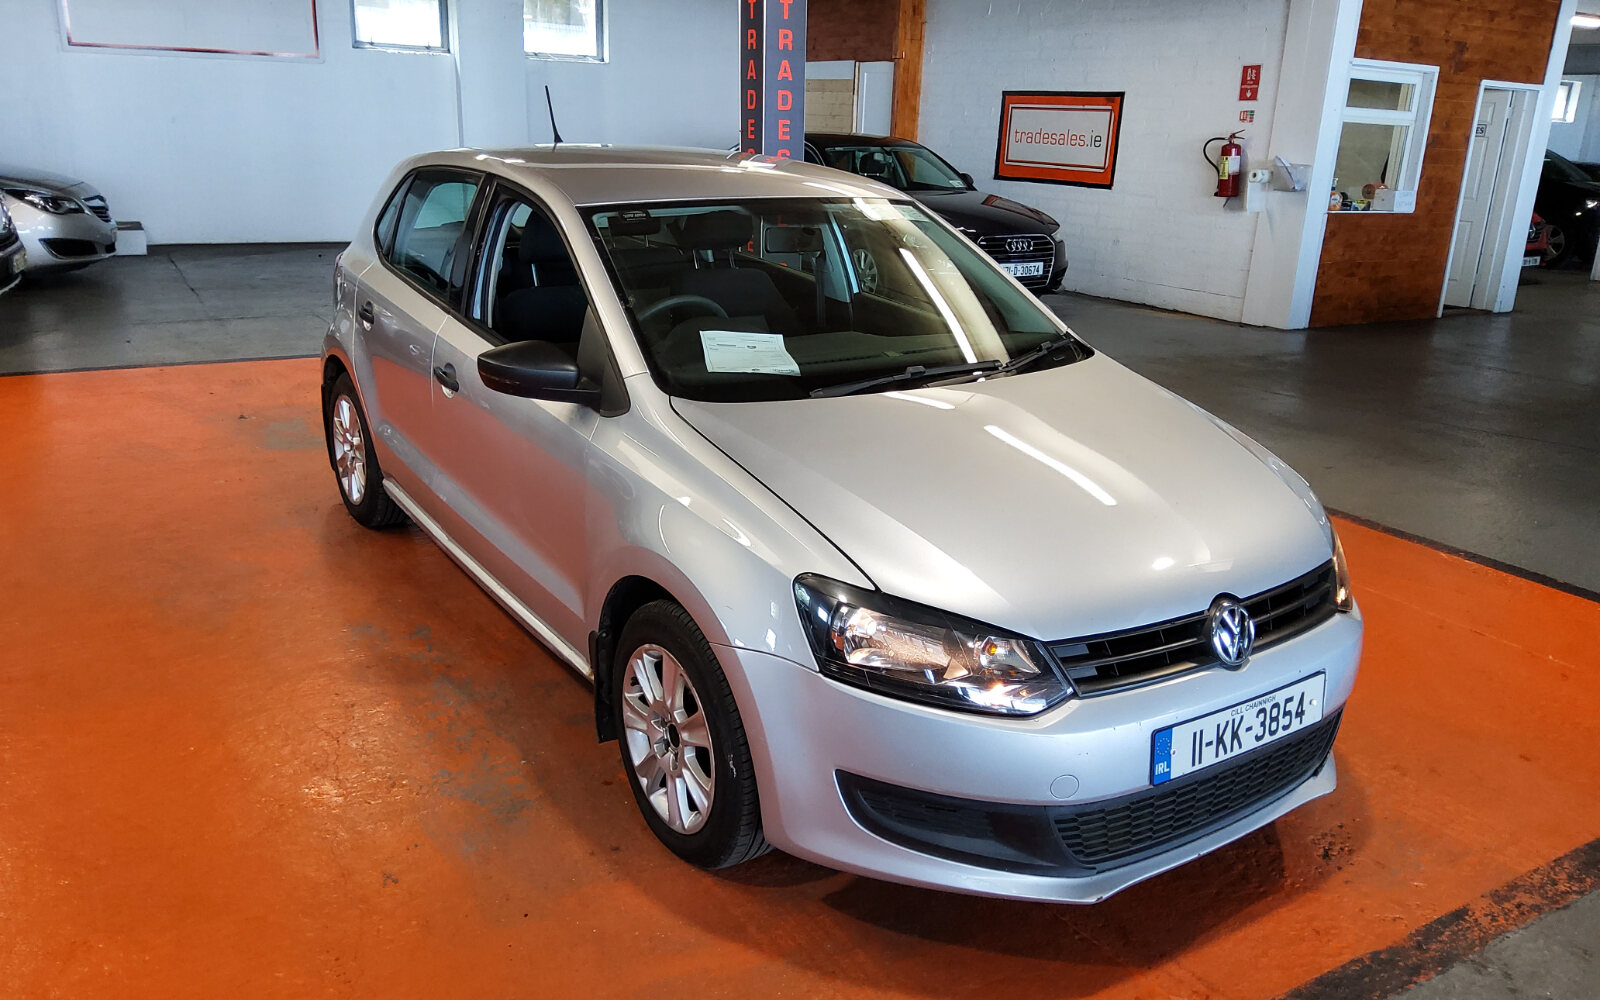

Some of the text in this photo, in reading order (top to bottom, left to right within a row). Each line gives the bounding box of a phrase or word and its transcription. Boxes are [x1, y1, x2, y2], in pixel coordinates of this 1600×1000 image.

[746, 0, 757, 153] TRADE
[1014, 128, 1102, 148] tradesales.ie
[1003, 264, 1040, 276] 71-D-30674
[1231, 707, 1244, 717] CILL
[1191, 691, 1306, 768] 11-KK-3854
[1155, 760, 1170, 776] IRL
